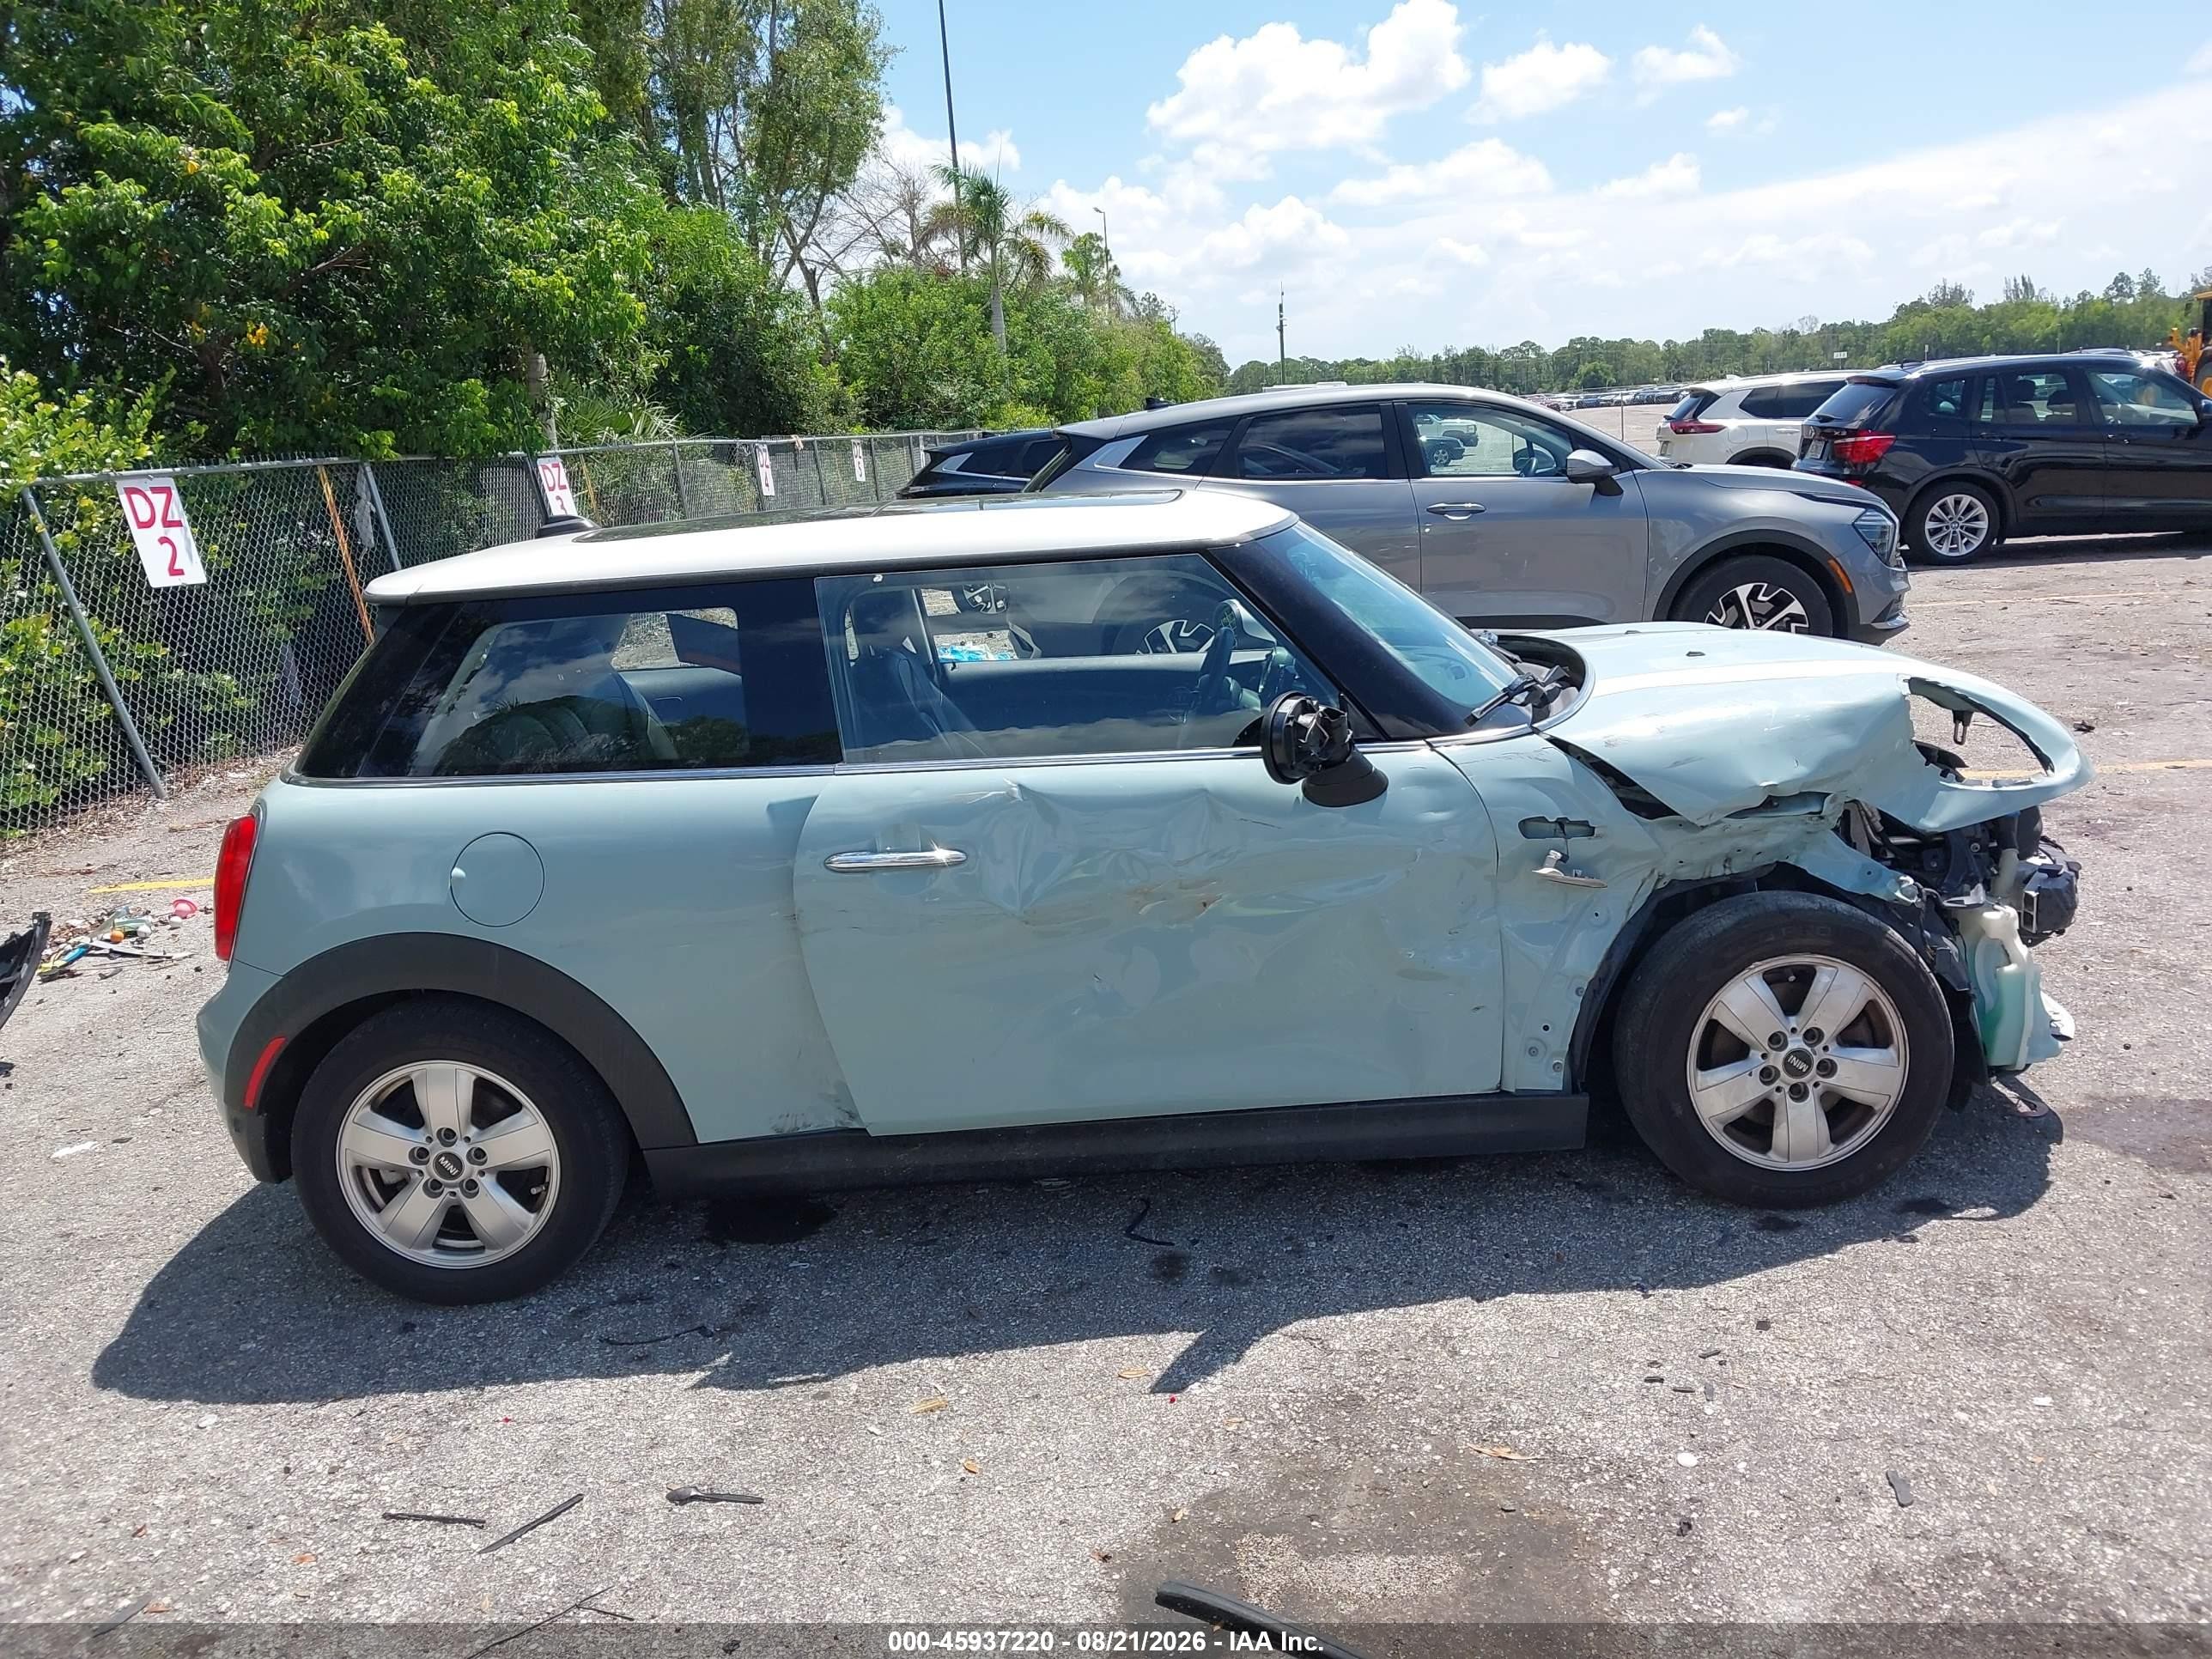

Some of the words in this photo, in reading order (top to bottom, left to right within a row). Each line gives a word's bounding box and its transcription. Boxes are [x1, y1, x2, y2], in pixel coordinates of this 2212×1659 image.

[756, 445, 770, 469] DZ
[540, 462, 568, 492] DZ
[764, 471, 770, 492] 4
[123, 486, 183, 529] DZ
[157, 536, 185, 576] 2
[1787, 1054, 1809, 1073] MINI
[438, 1156, 459, 1176] MINI
